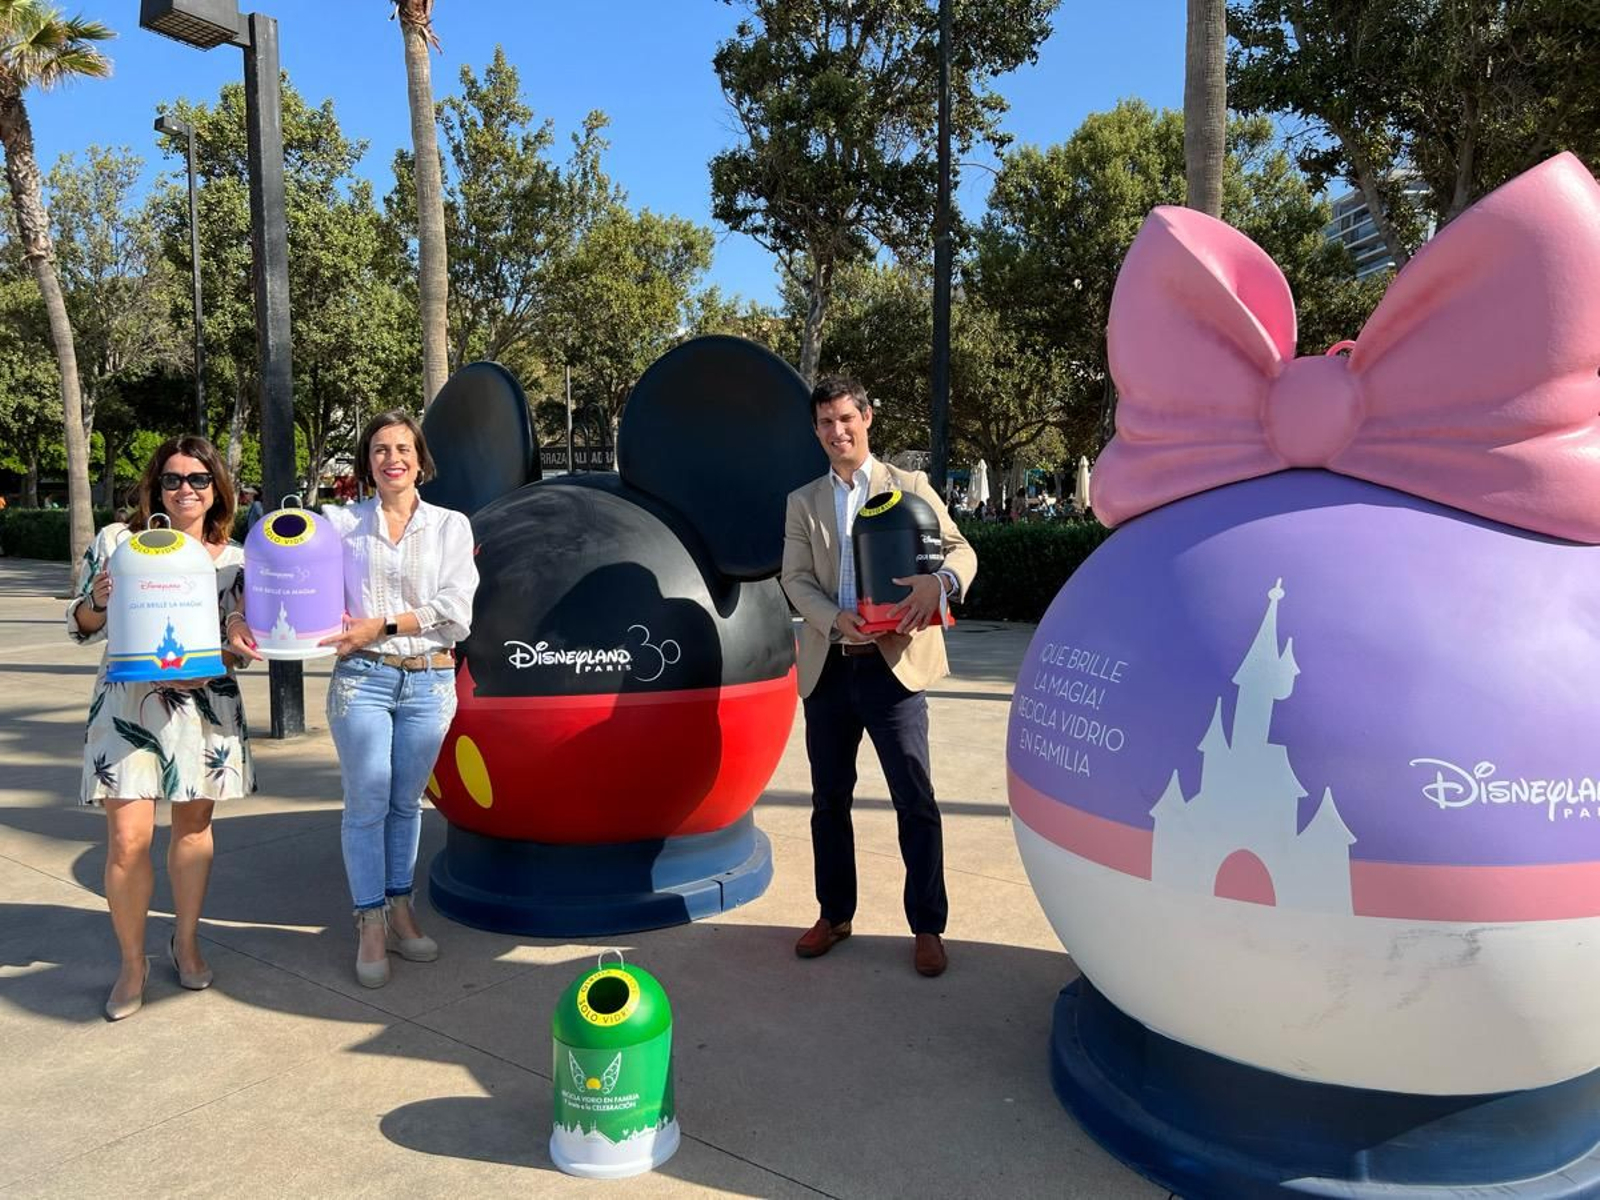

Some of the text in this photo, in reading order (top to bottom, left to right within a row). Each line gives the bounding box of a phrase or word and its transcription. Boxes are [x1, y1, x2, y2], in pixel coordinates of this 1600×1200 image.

[585, 664, 632, 673] PARIS
[1066, 648, 1129, 684] BRILLE
[1034, 671, 1106, 711] LA MAGIA!
[1061, 710, 1125, 752] VIDRIO
[1019, 727, 1091, 777] EN FAMILIA
[578, 999, 598, 1022] SOLO
[581, 1096, 603, 1104] VIDRIO
[603, 1096, 613, 1104] EN
[592, 1100, 637, 1111] CELEBRACIÓN
